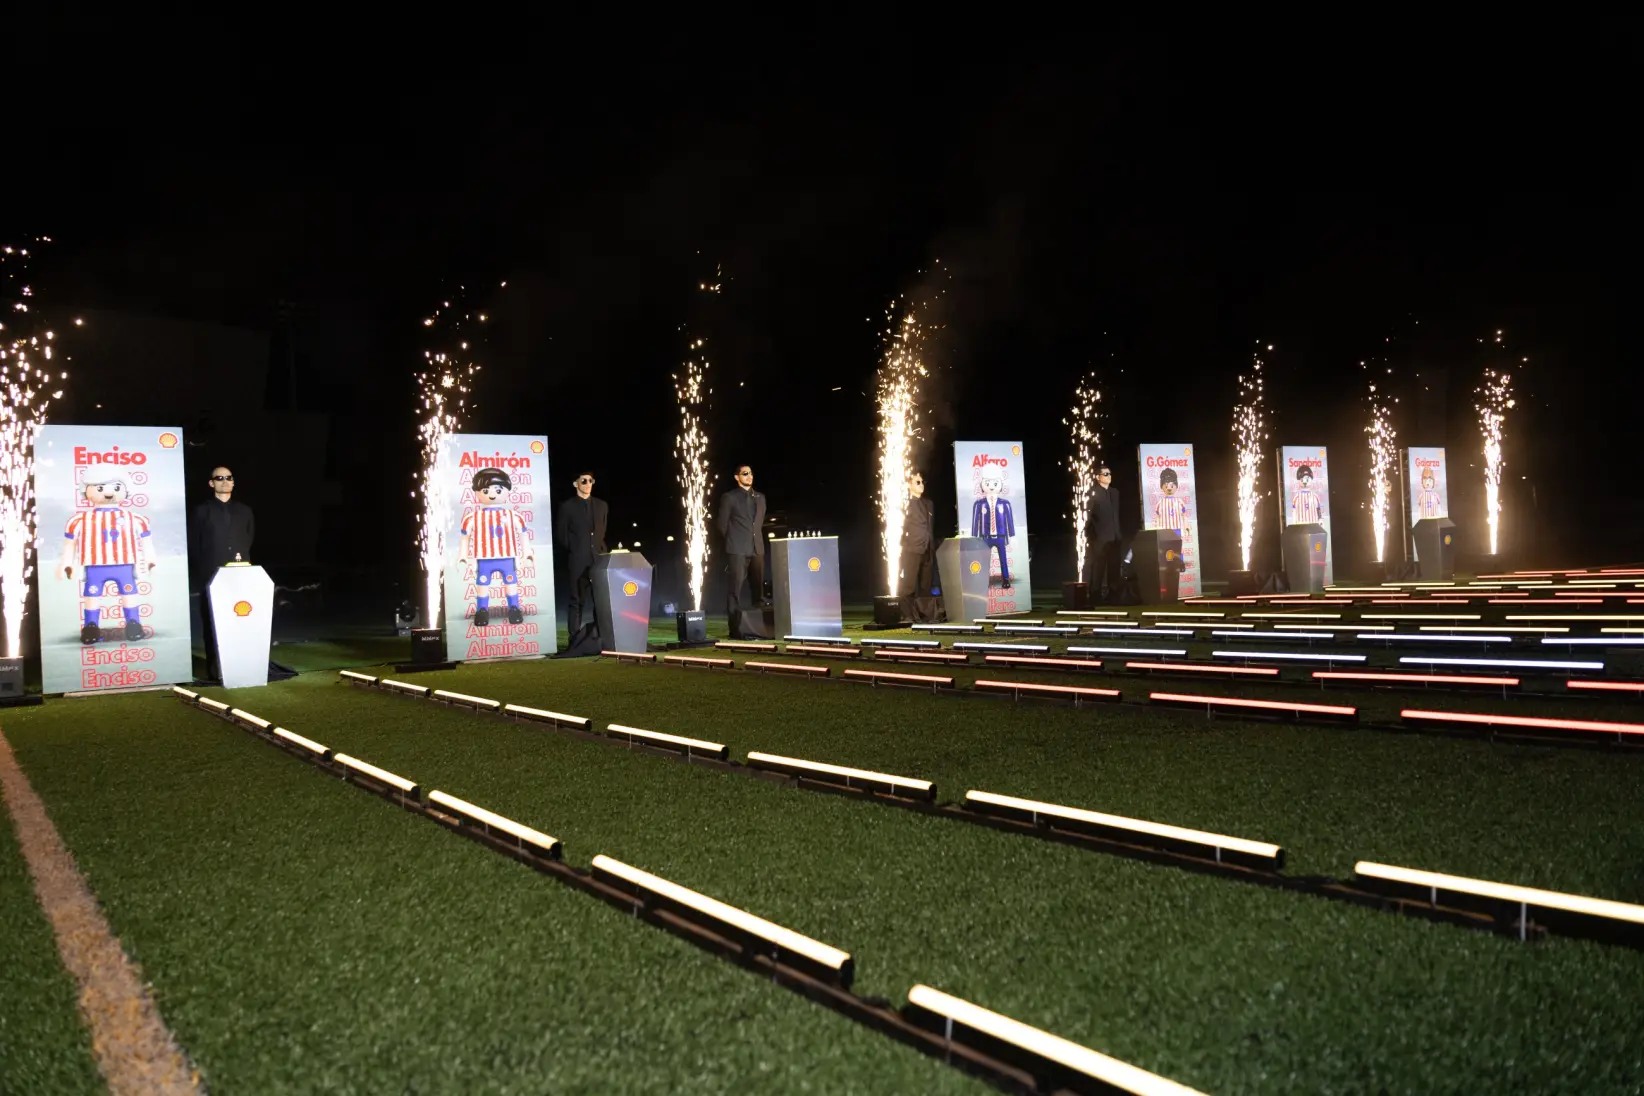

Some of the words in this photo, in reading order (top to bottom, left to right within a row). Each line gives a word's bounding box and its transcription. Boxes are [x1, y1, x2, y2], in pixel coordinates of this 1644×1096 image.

[74, 446, 147, 465] Enciso
[459, 451, 531, 468] Almirón
[972, 454, 1008, 467] Alfaro
[1146, 456, 1188, 468] G.Gómez
[1288, 456, 1322, 468] Sanabria
[102, 528, 120, 543] 19
[489, 525, 504, 539] 10
[81, 643, 155, 666] Enciso
[466, 636, 540, 659] Almirón
[82, 664, 157, 688] Enciso
